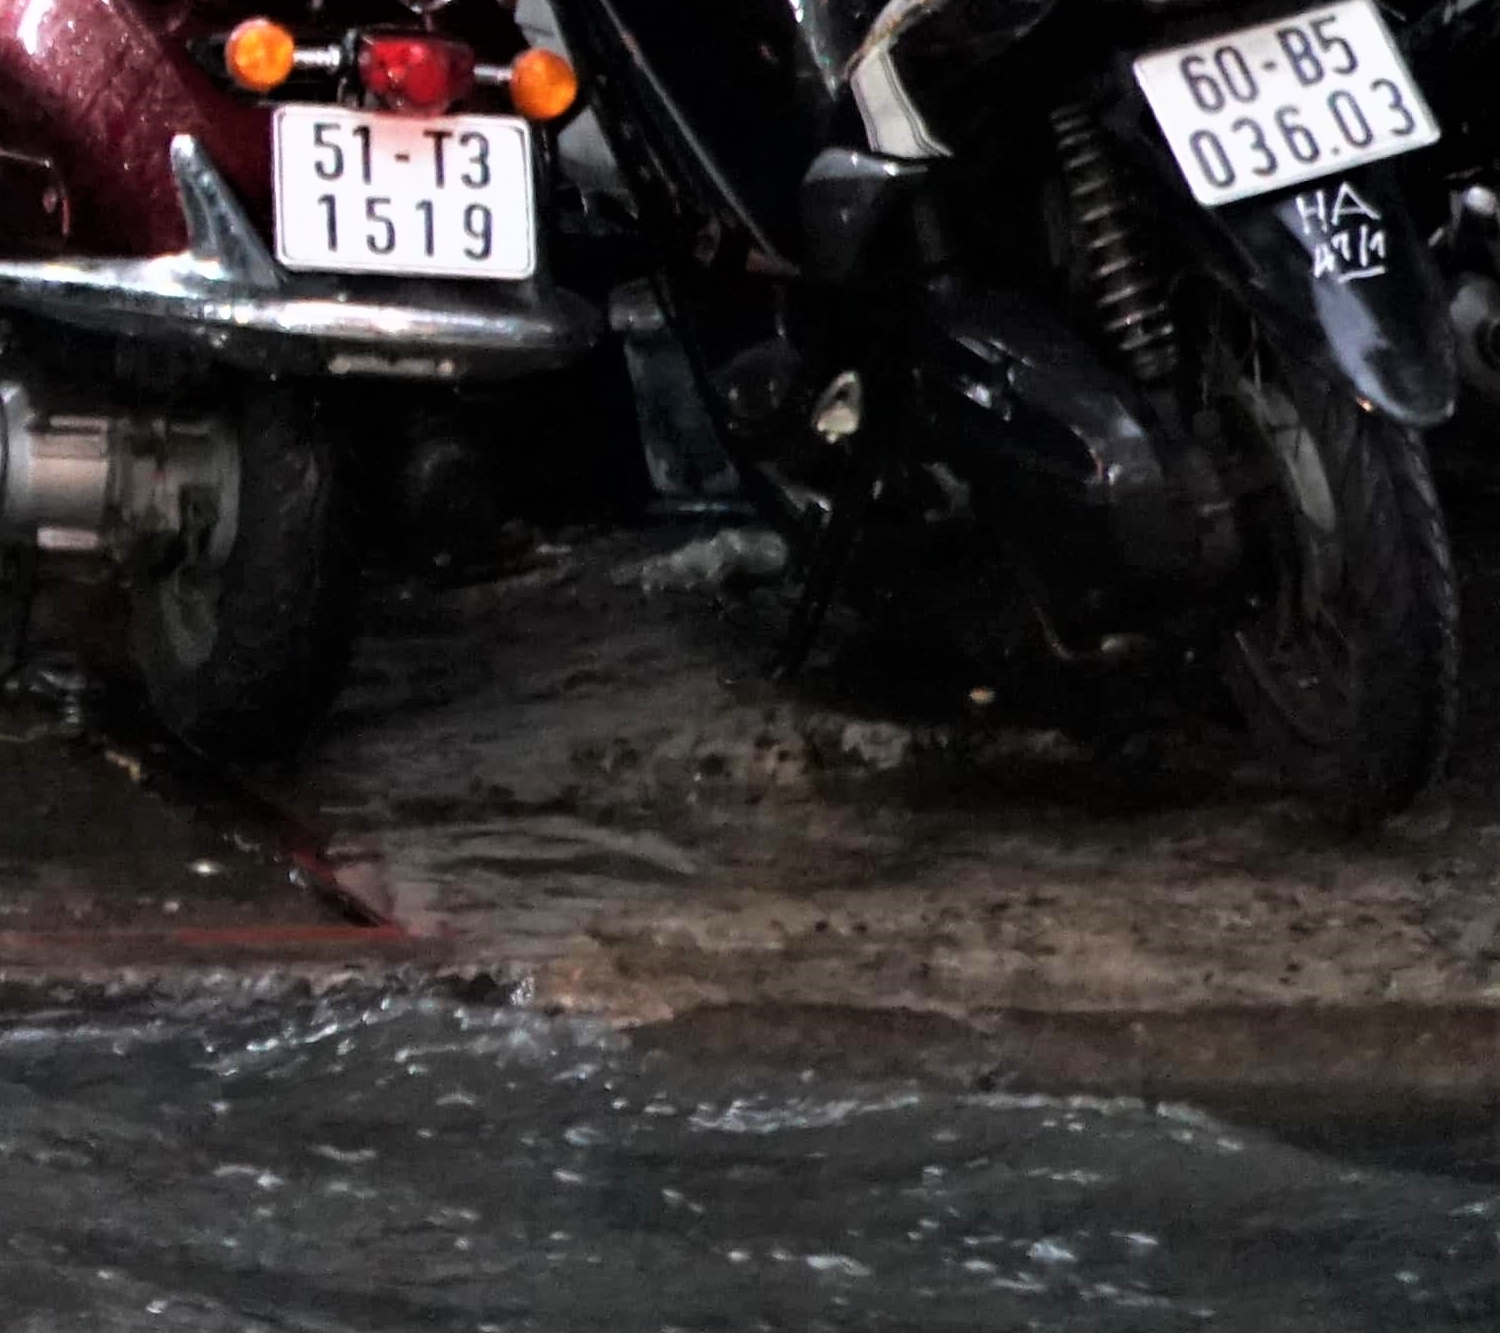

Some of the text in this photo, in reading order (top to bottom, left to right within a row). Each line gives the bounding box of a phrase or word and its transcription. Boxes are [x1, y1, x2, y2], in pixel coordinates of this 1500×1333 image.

[1178, 15, 1358, 114] 60-B5
[313, 121, 492, 190] 51-T3
[1188, 77, 1417, 189] 036.03
[318, 193, 493, 262] 1519
